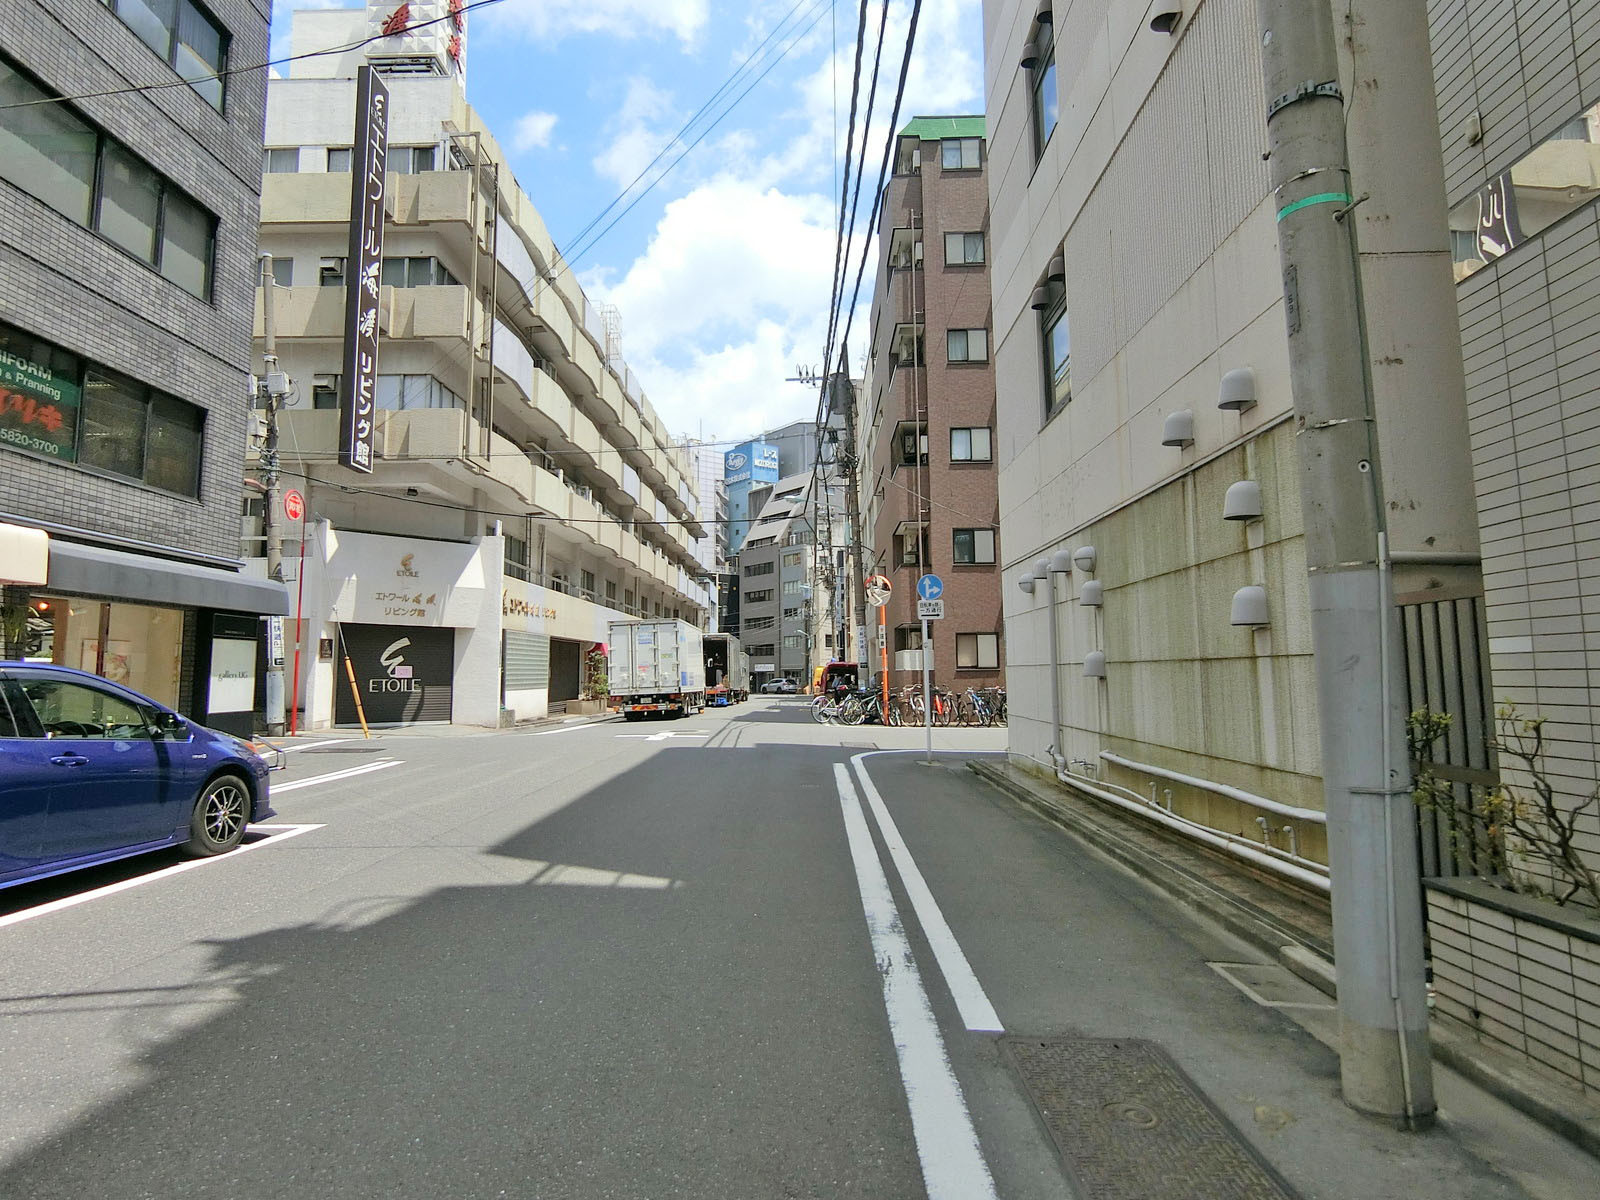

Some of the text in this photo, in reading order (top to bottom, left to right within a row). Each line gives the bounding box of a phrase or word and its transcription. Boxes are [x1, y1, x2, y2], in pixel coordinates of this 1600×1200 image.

[16, 372, 61, 401] Pranning
[0, 428, 59, 454] 5820-3700
[397, 570, 419, 578] ETOILE
[384, 607, 426, 617] リビング館
[369, 678, 421, 693] ETOILE
